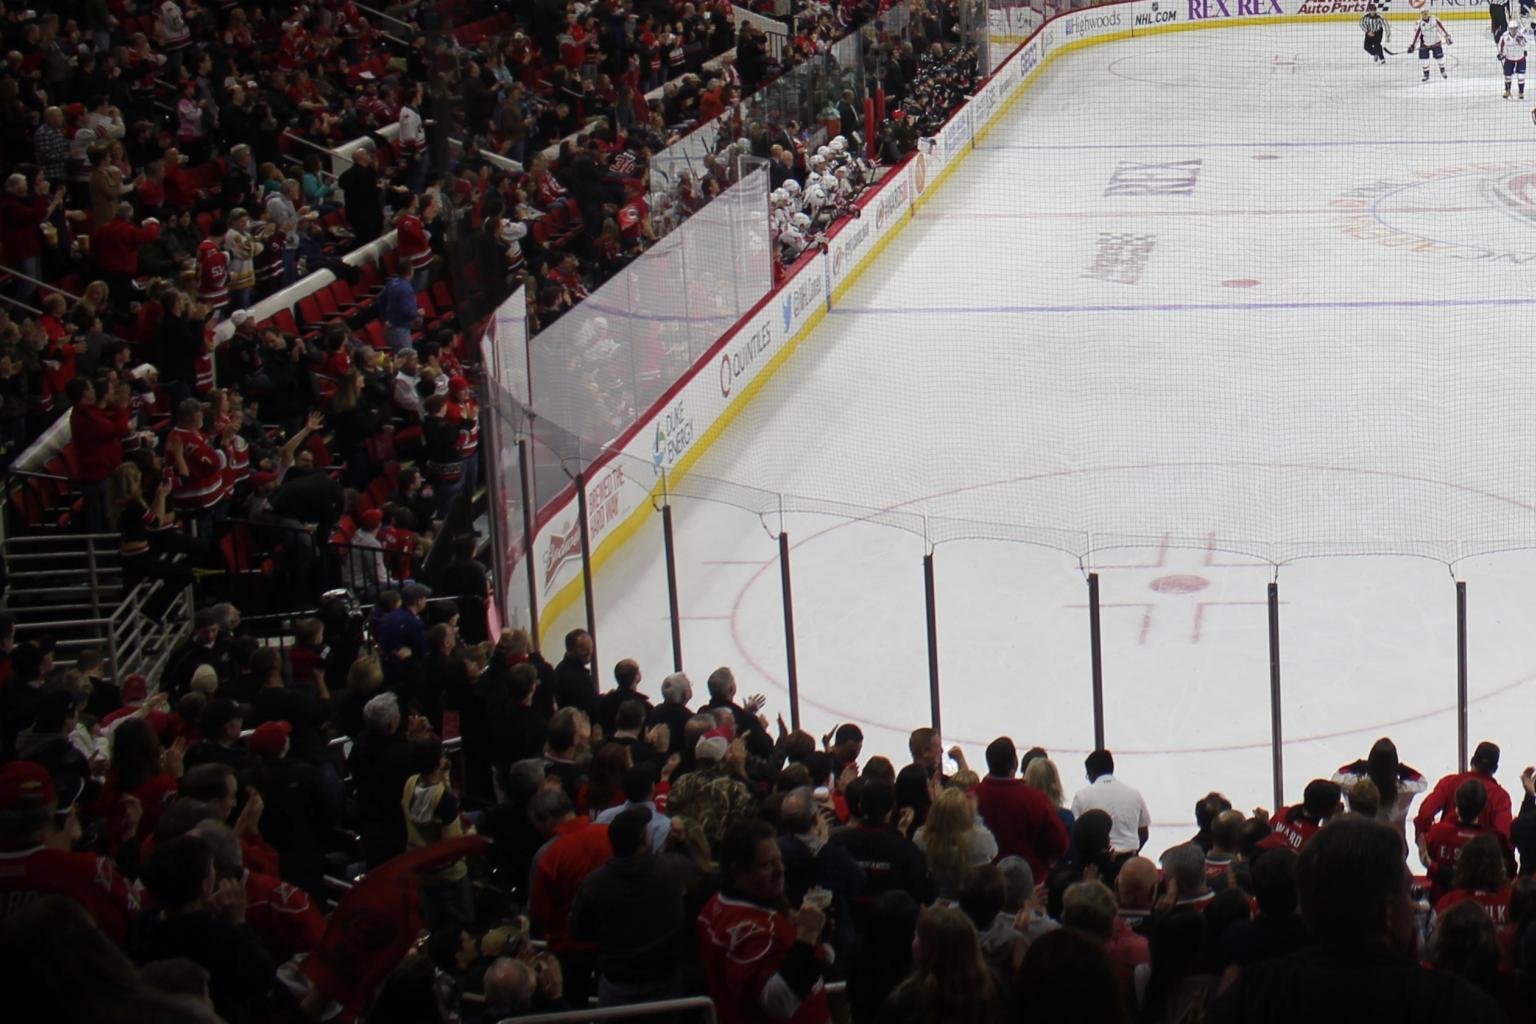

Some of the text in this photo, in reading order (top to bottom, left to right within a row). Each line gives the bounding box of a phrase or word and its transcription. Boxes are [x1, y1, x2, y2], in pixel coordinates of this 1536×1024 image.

[1135, 10, 1177, 26] NHL.COM
[1297, 1, 1367, 15] Auto Parts
[1071, 10, 1121, 37] Highwoods
[732, 319, 771, 378] QUINTILES
[1275, 820, 1303, 849] WARD
